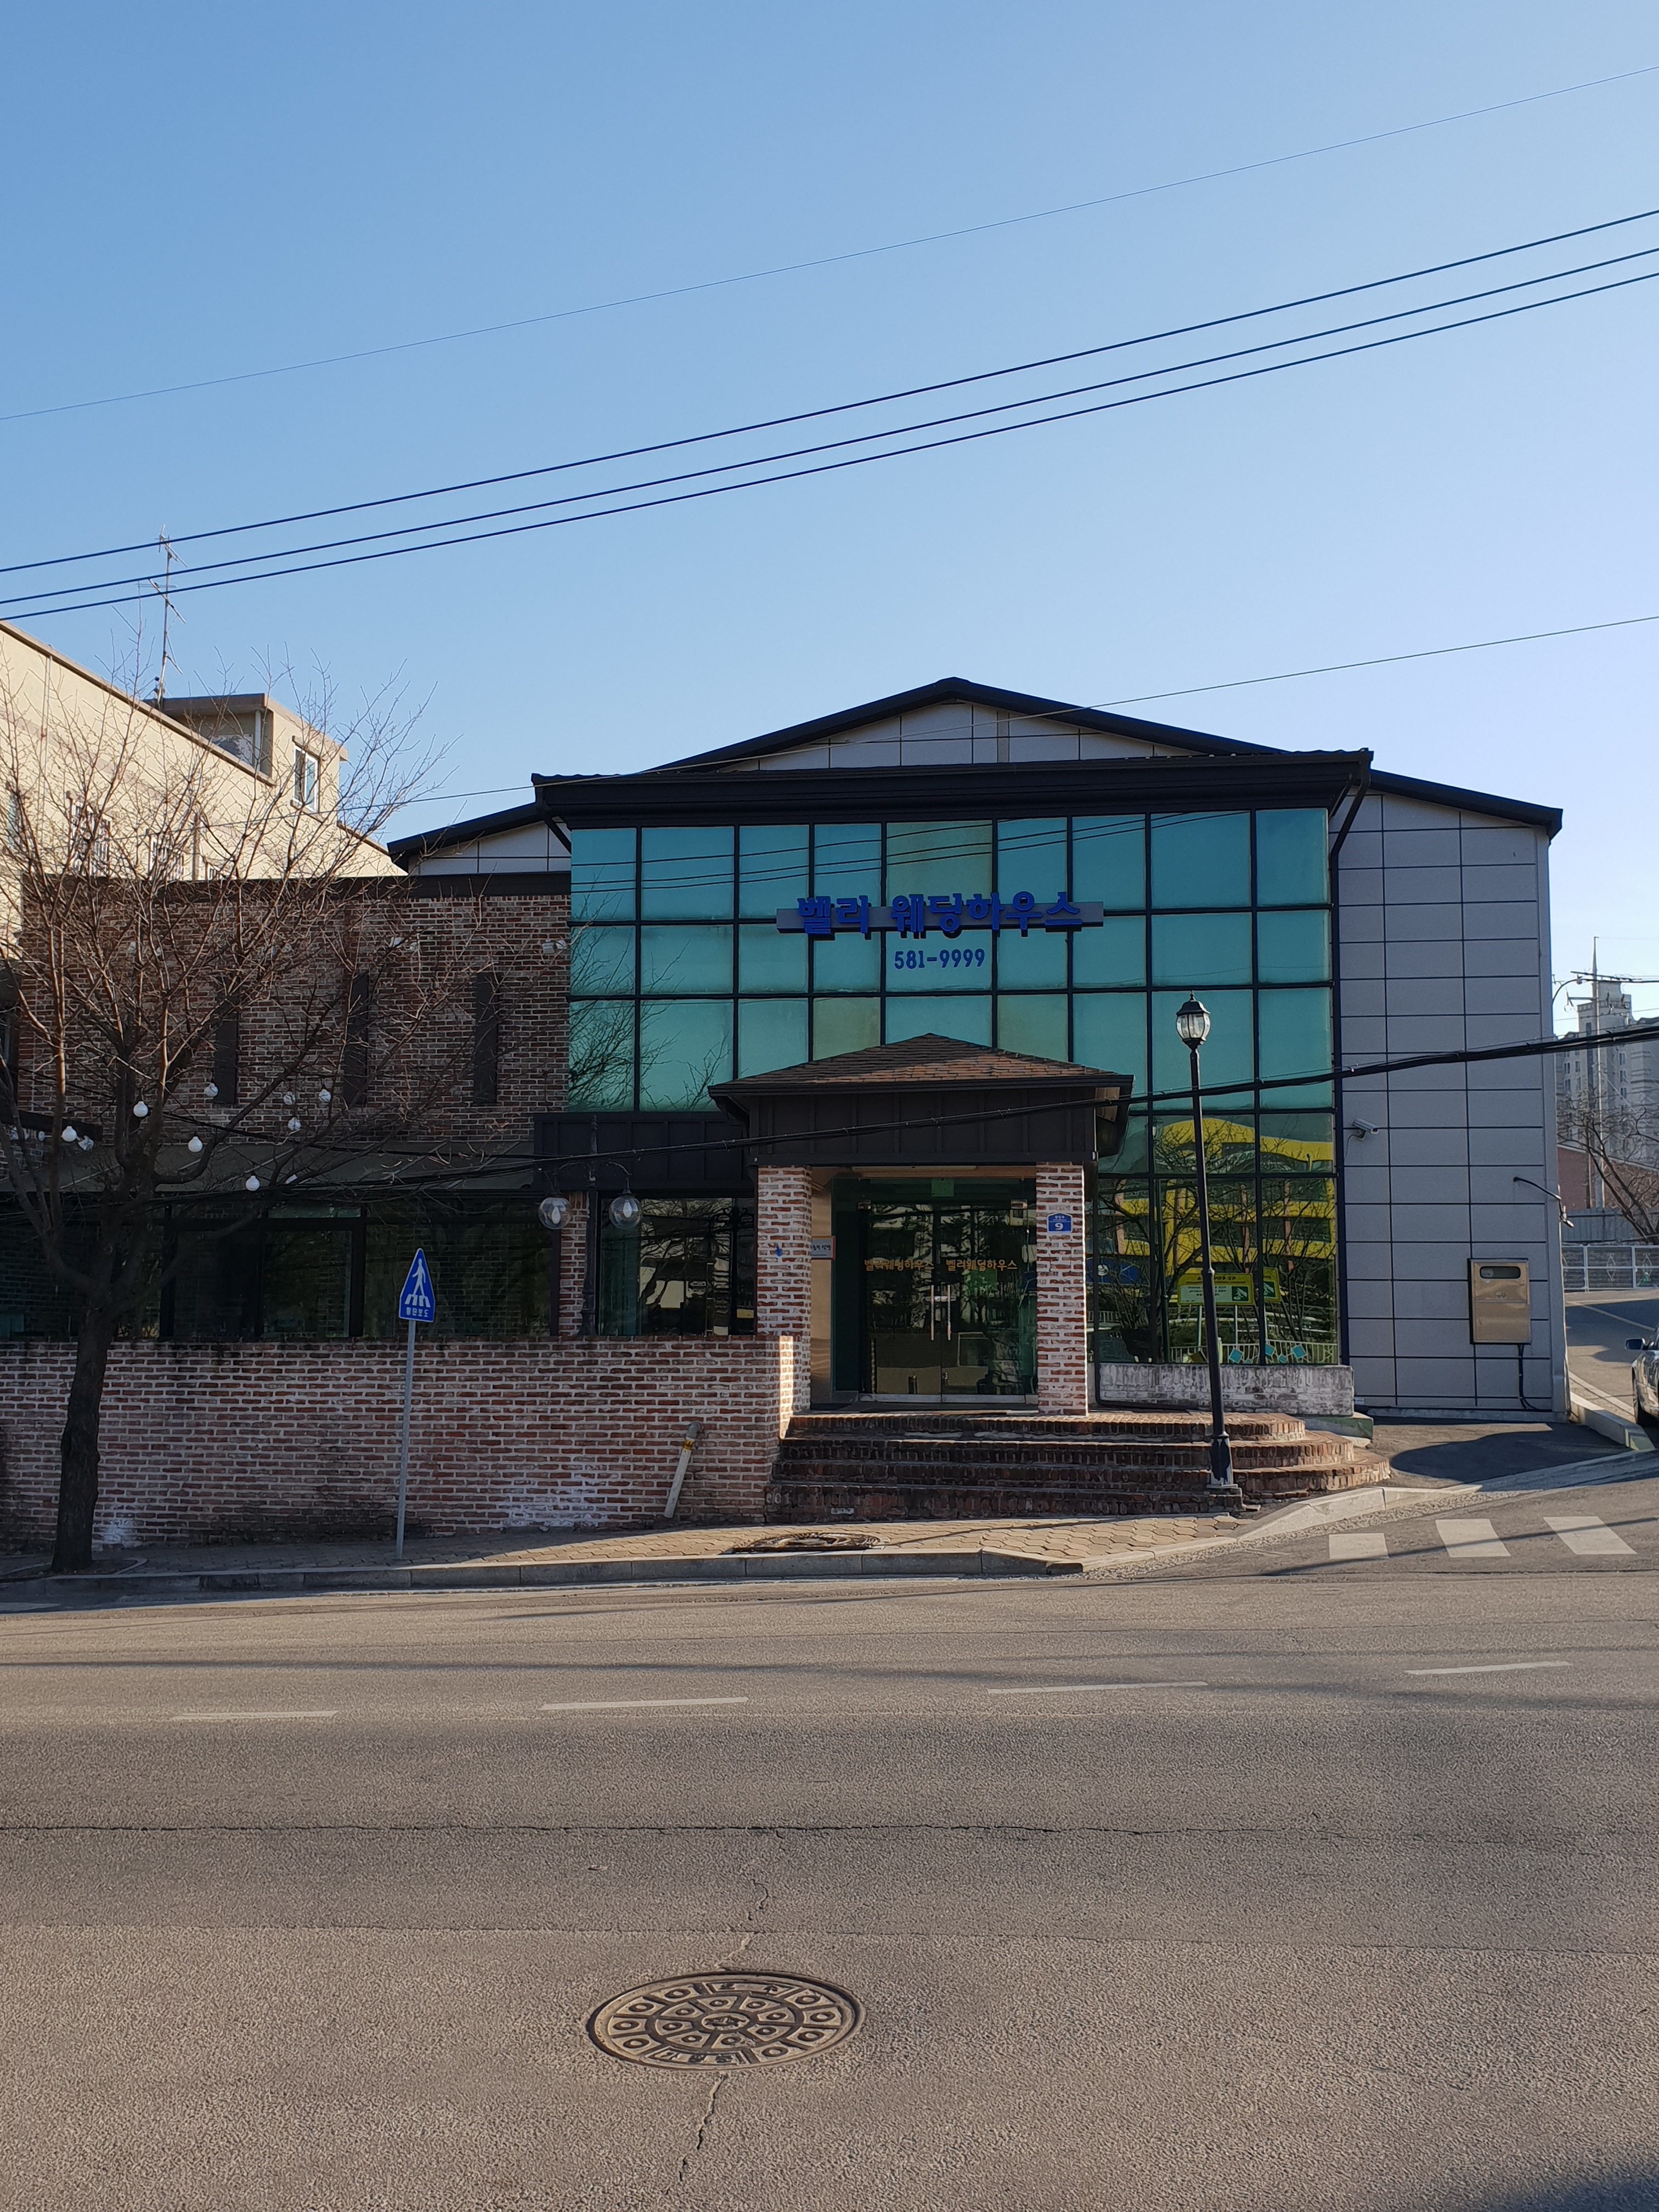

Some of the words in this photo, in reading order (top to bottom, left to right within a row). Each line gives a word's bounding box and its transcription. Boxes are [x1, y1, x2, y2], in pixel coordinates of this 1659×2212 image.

[890, 891, 1082, 933] 웨딩하우스
[894, 949, 985, 969] 581-9999
[406, 1307, 429, 1317] 횡단보도
